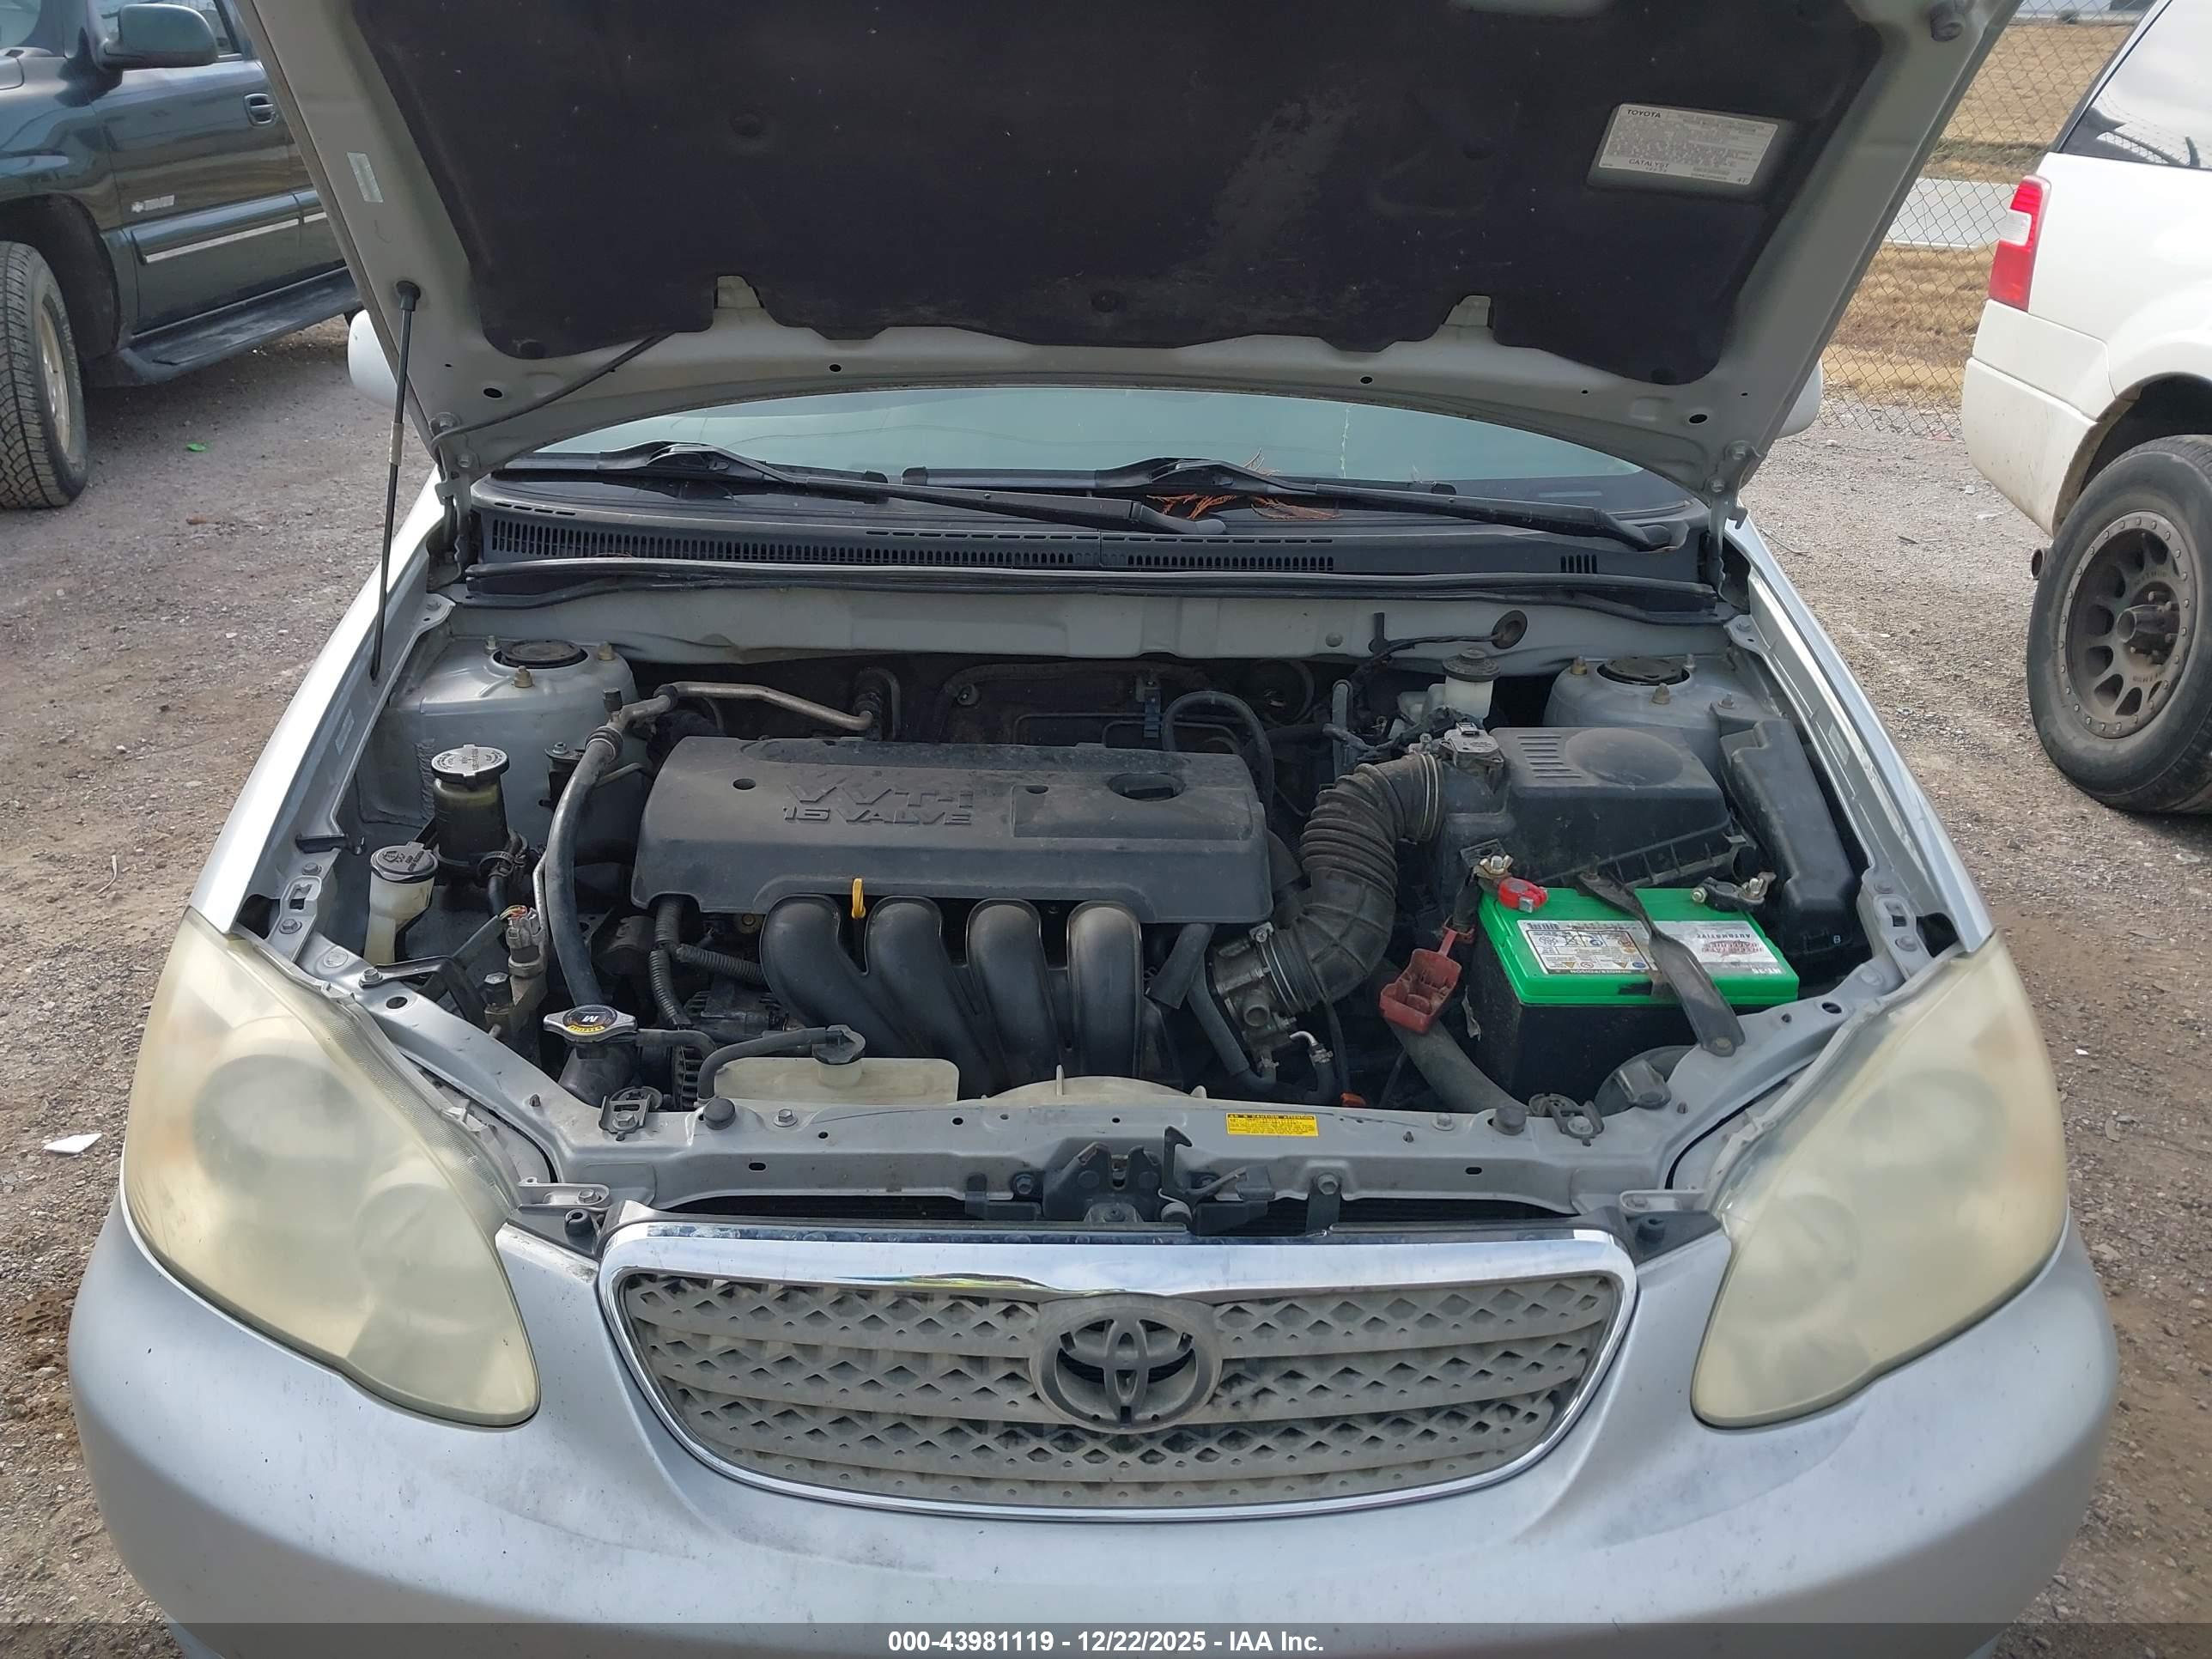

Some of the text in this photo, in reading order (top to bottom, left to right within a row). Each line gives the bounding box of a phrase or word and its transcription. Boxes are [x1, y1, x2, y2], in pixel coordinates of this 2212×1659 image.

[1626, 109, 1662, 118] TOYOTA
[1628, 158, 1669, 168] CATALYST
[782, 807, 972, 825] 16 VALVE
